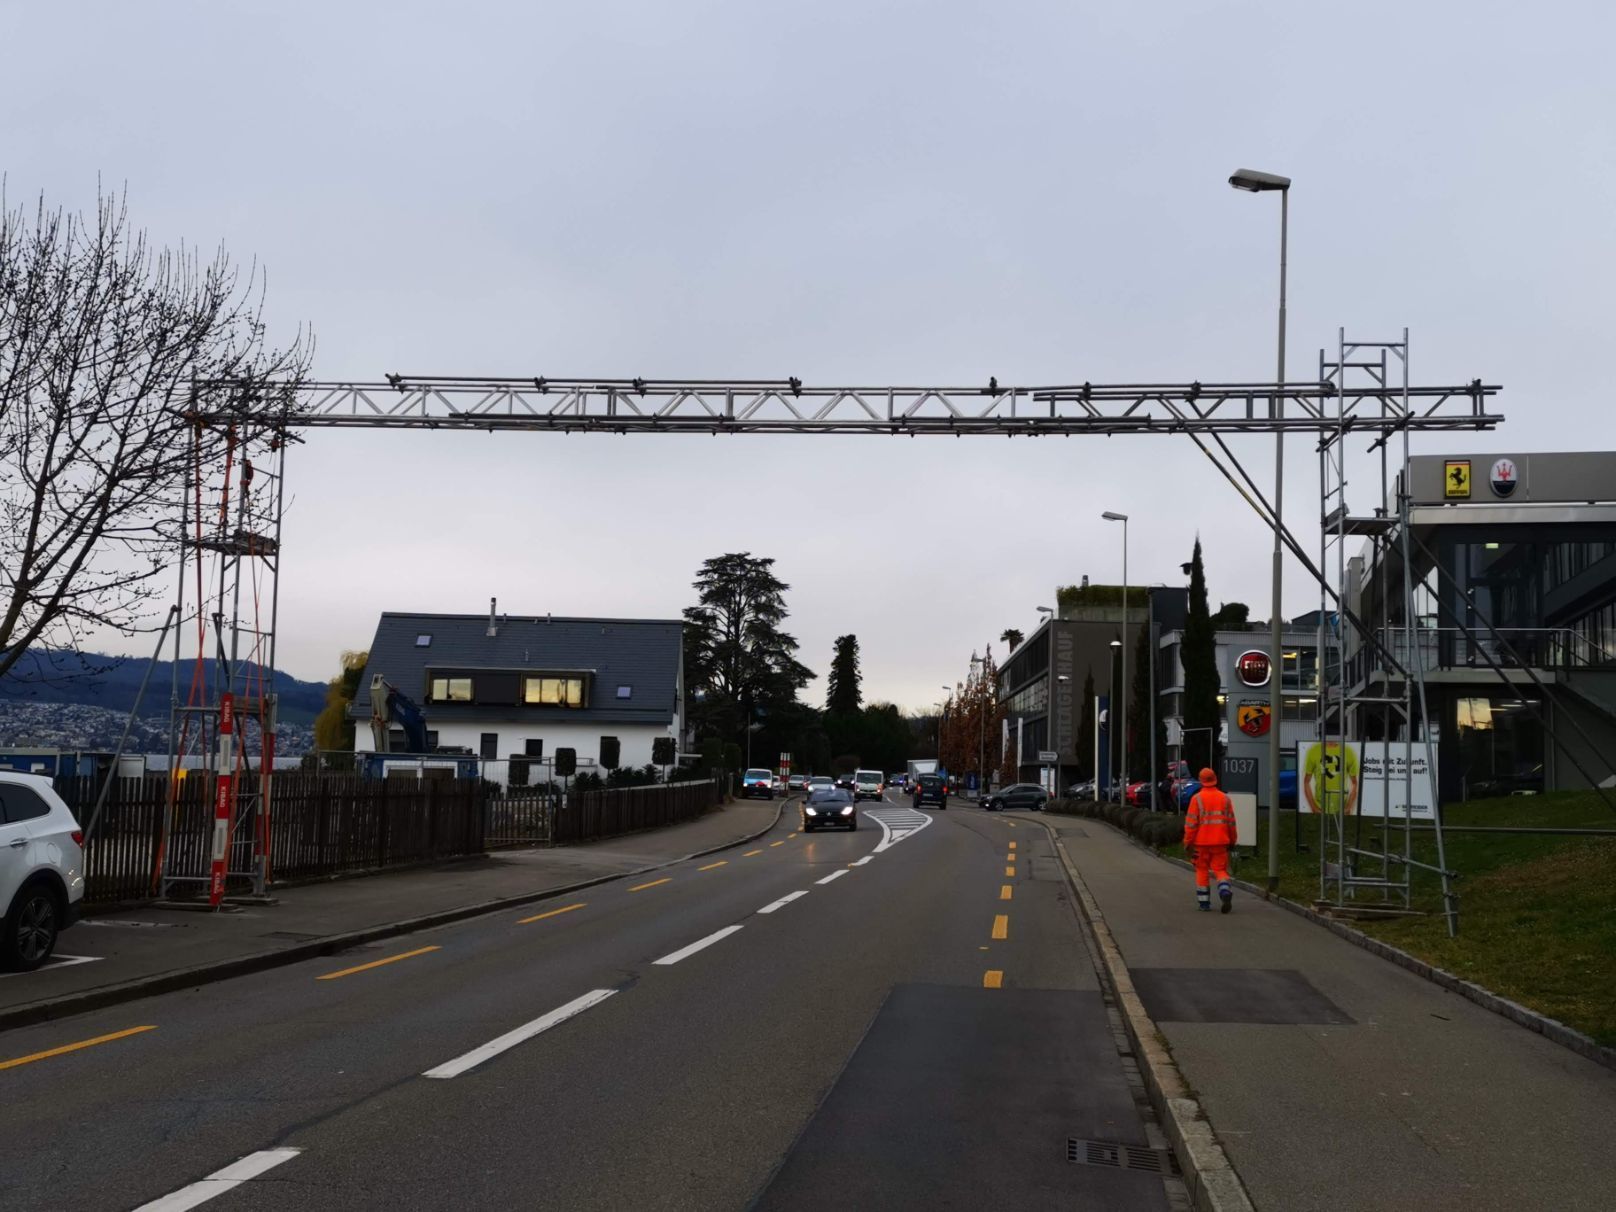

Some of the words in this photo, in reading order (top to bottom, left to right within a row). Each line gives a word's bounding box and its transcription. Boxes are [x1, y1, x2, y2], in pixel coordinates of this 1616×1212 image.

[1223, 759, 1254, 774] 1037
[1396, 757, 1427, 766] Zuunft.
[219, 785, 227, 808] KIBAG
